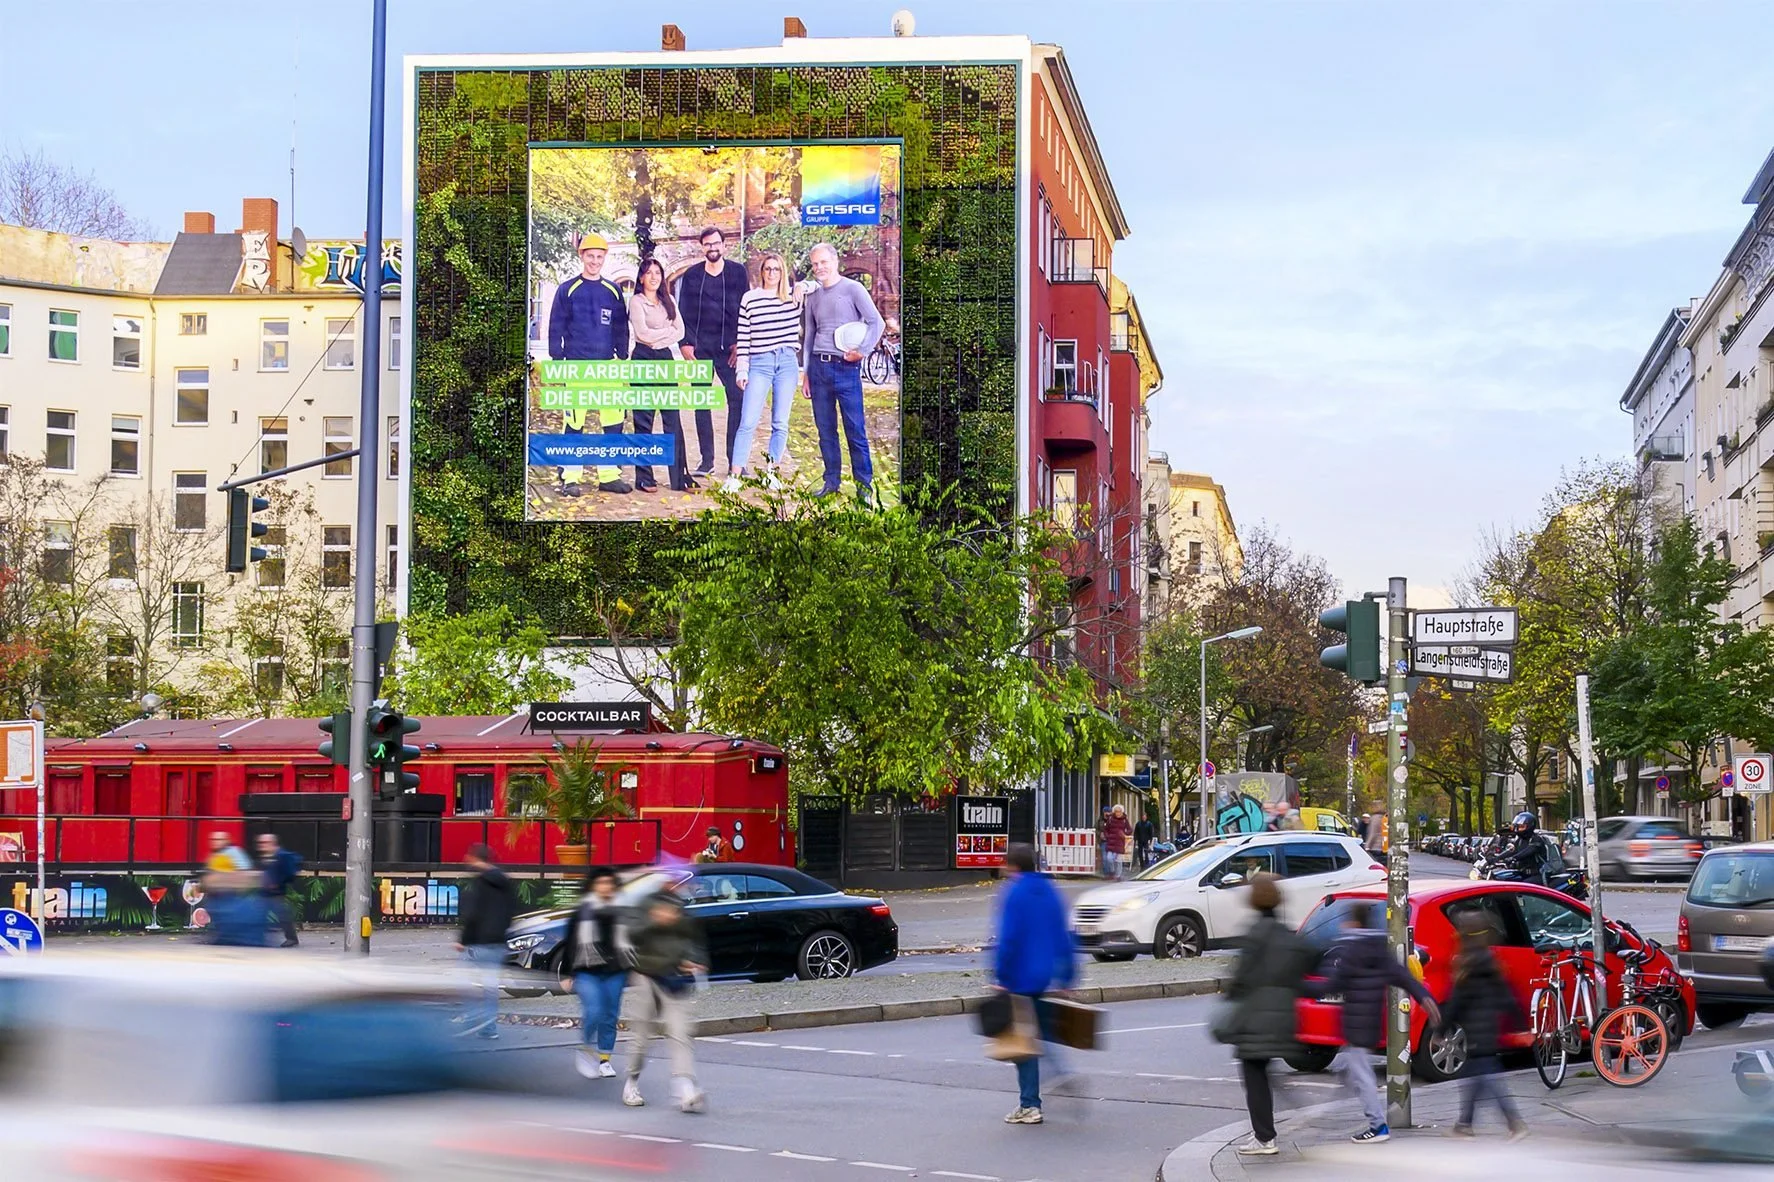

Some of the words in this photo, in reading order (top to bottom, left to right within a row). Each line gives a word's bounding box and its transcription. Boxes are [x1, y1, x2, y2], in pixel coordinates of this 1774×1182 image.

[806, 204, 876, 215] GASAG
[545, 364, 578, 379] WIR
[583, 364, 668, 379] ARBEITEN
[674, 361, 708, 379] FÜR
[545, 391, 573, 406] DIE
[579, 390, 720, 406] ENERGIEWENDE.
[545, 445, 663, 457] www.gasag-gruppe.de
[1425, 615, 1504, 636] Hauptstraße
[536, 711, 641, 722] COCKTAILBAR
[1746, 765, 1760, 776] 30
[12, 882, 107, 919] train
[379, 879, 459, 915] train
